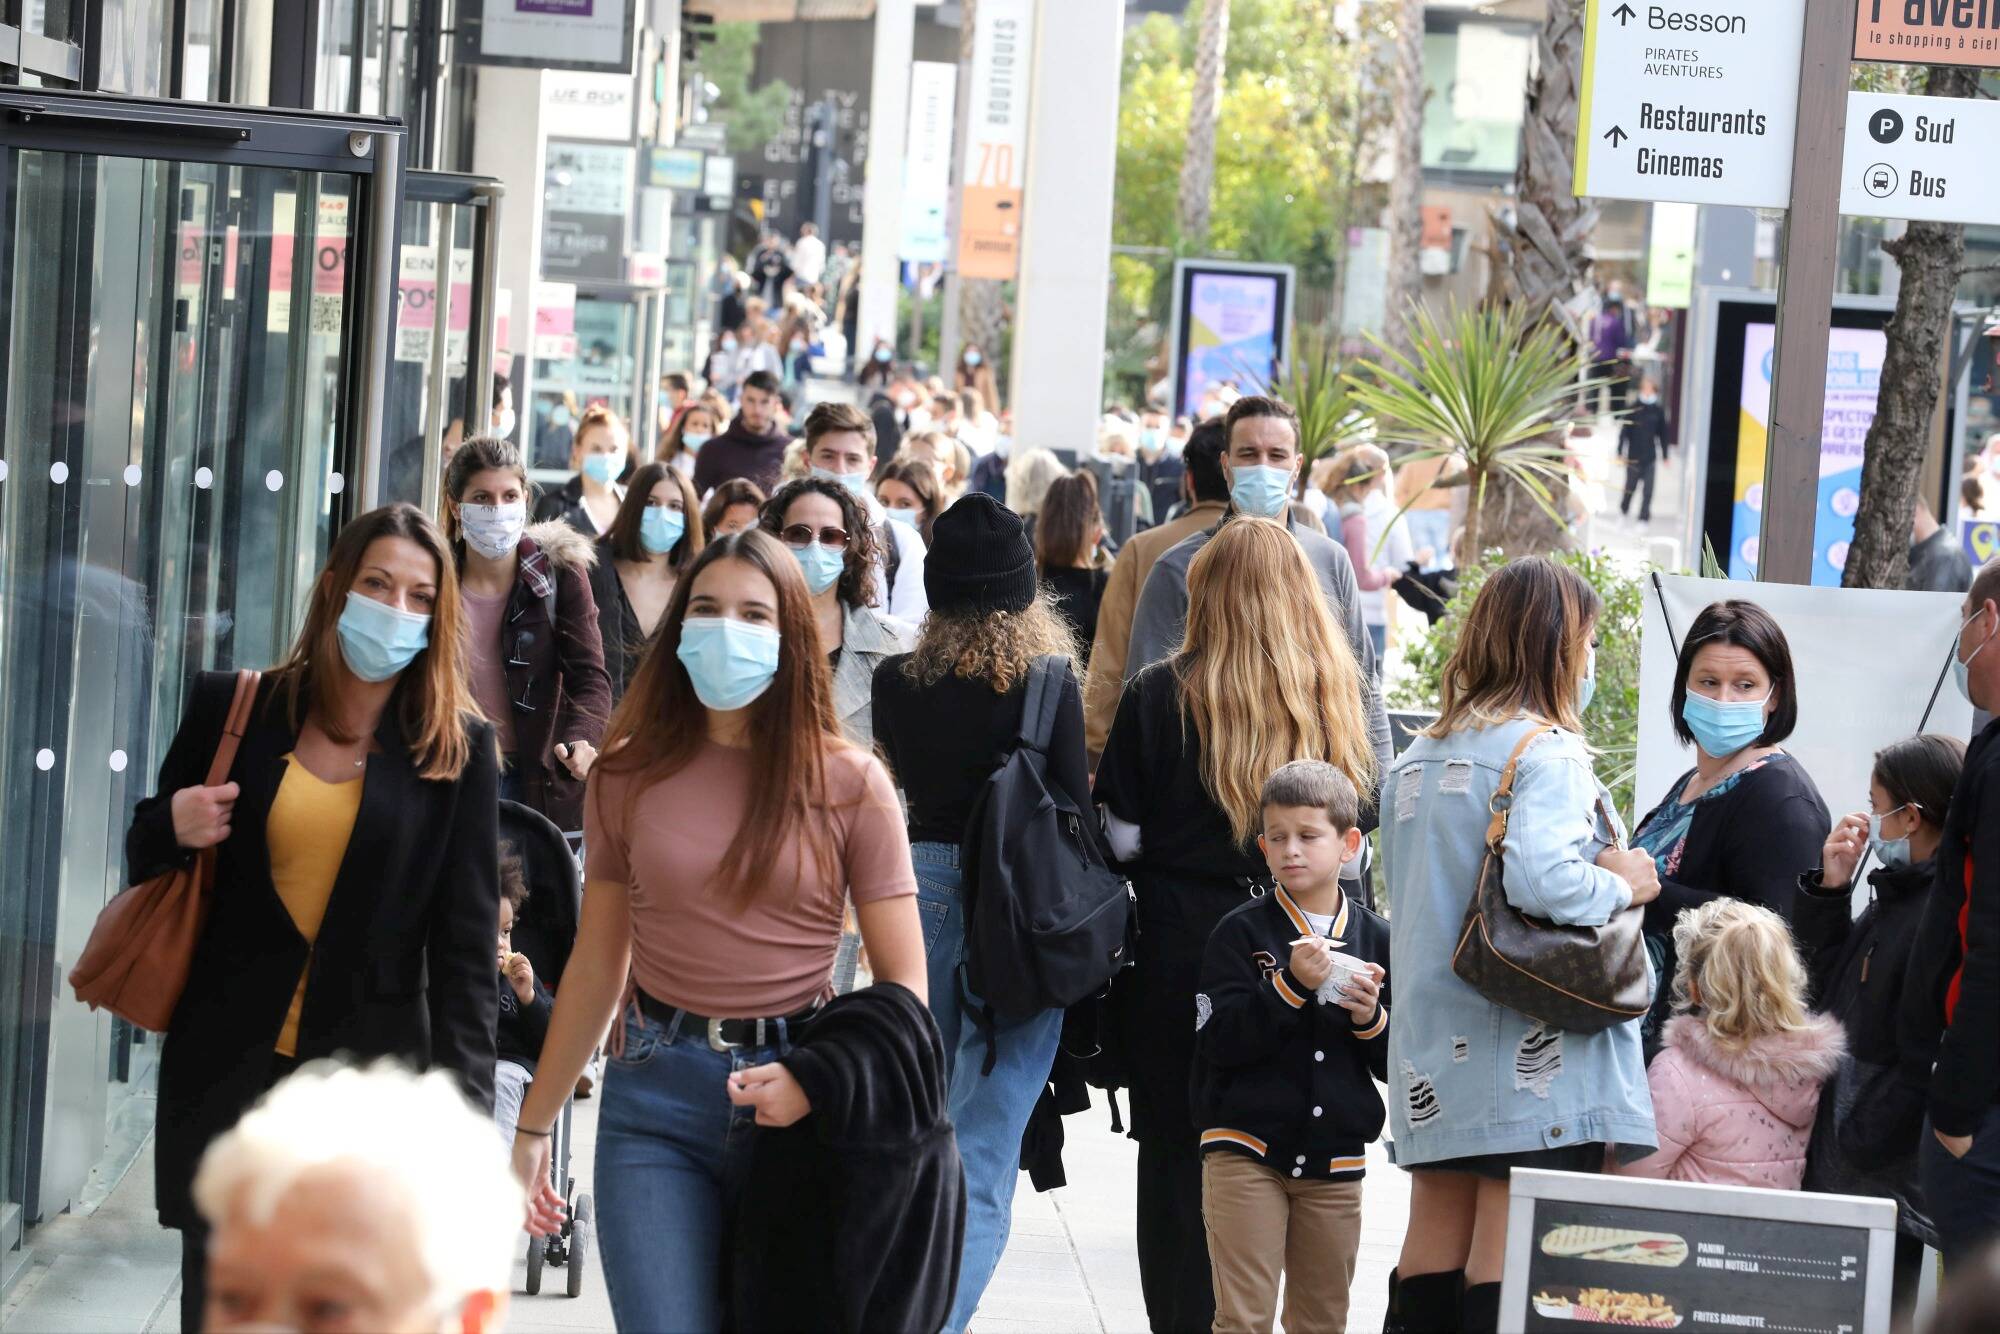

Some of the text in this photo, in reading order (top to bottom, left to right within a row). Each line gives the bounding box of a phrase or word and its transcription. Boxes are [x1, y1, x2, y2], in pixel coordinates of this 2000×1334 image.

[1648, 6, 1746, 34] Besson
[1869, 30, 1998, 51] le shopping à ciel
[1645, 47, 1699, 62] PIRATES
[1643, 63, 1723, 79] AVENTURES
[1640, 102, 1766, 136] Restaurants
[1914, 115, 1955, 144] Sud
[1637, 147, 1724, 179] Cinemas
[1909, 169, 1946, 199] Bus
[1697, 1242, 1725, 1255] PANINI
[1696, 1256, 1724, 1270] PANINI
[1724, 1259, 1759, 1273] NUTELLA
[1692, 1310, 1765, 1328] FRITES BARQUETTE
